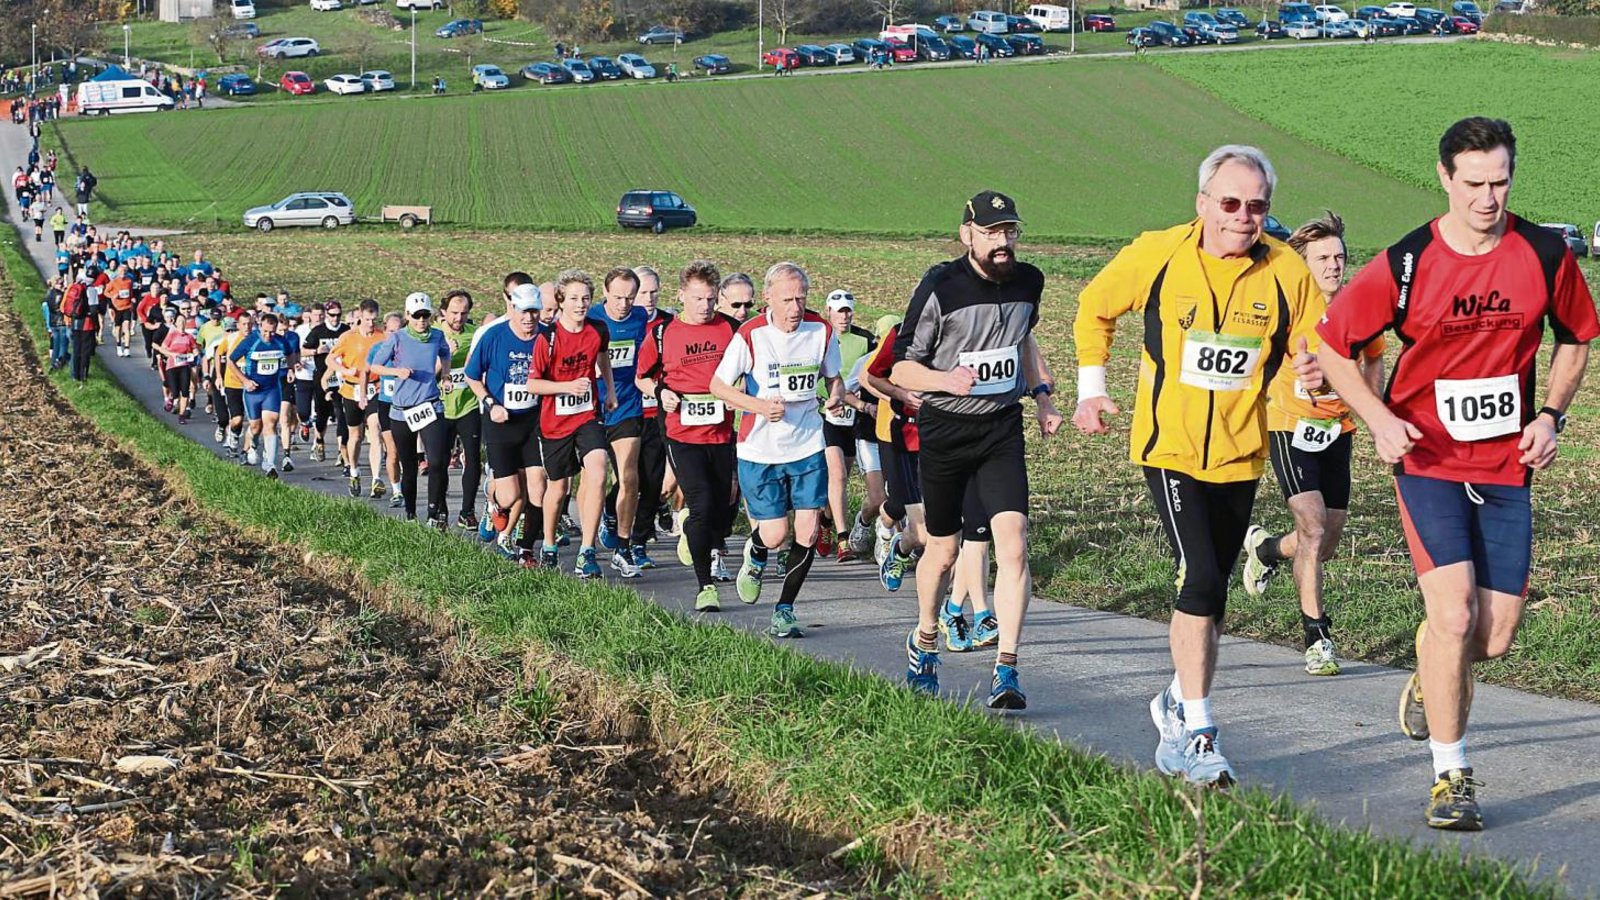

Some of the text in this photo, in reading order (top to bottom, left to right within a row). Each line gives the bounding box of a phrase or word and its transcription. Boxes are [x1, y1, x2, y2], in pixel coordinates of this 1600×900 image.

[1453, 291, 1510, 317] WiLa
[1443, 319, 1520, 334] Bestickung
[685, 340, 717, 355] WiLa
[1197, 346, 1249, 375] 862
[970, 358, 1015, 382] 040
[788, 373, 815, 391] 878
[687, 402, 716, 416] 855
[1444, 391, 1515, 422] 1058
[407, 407, 433, 425] 1046
